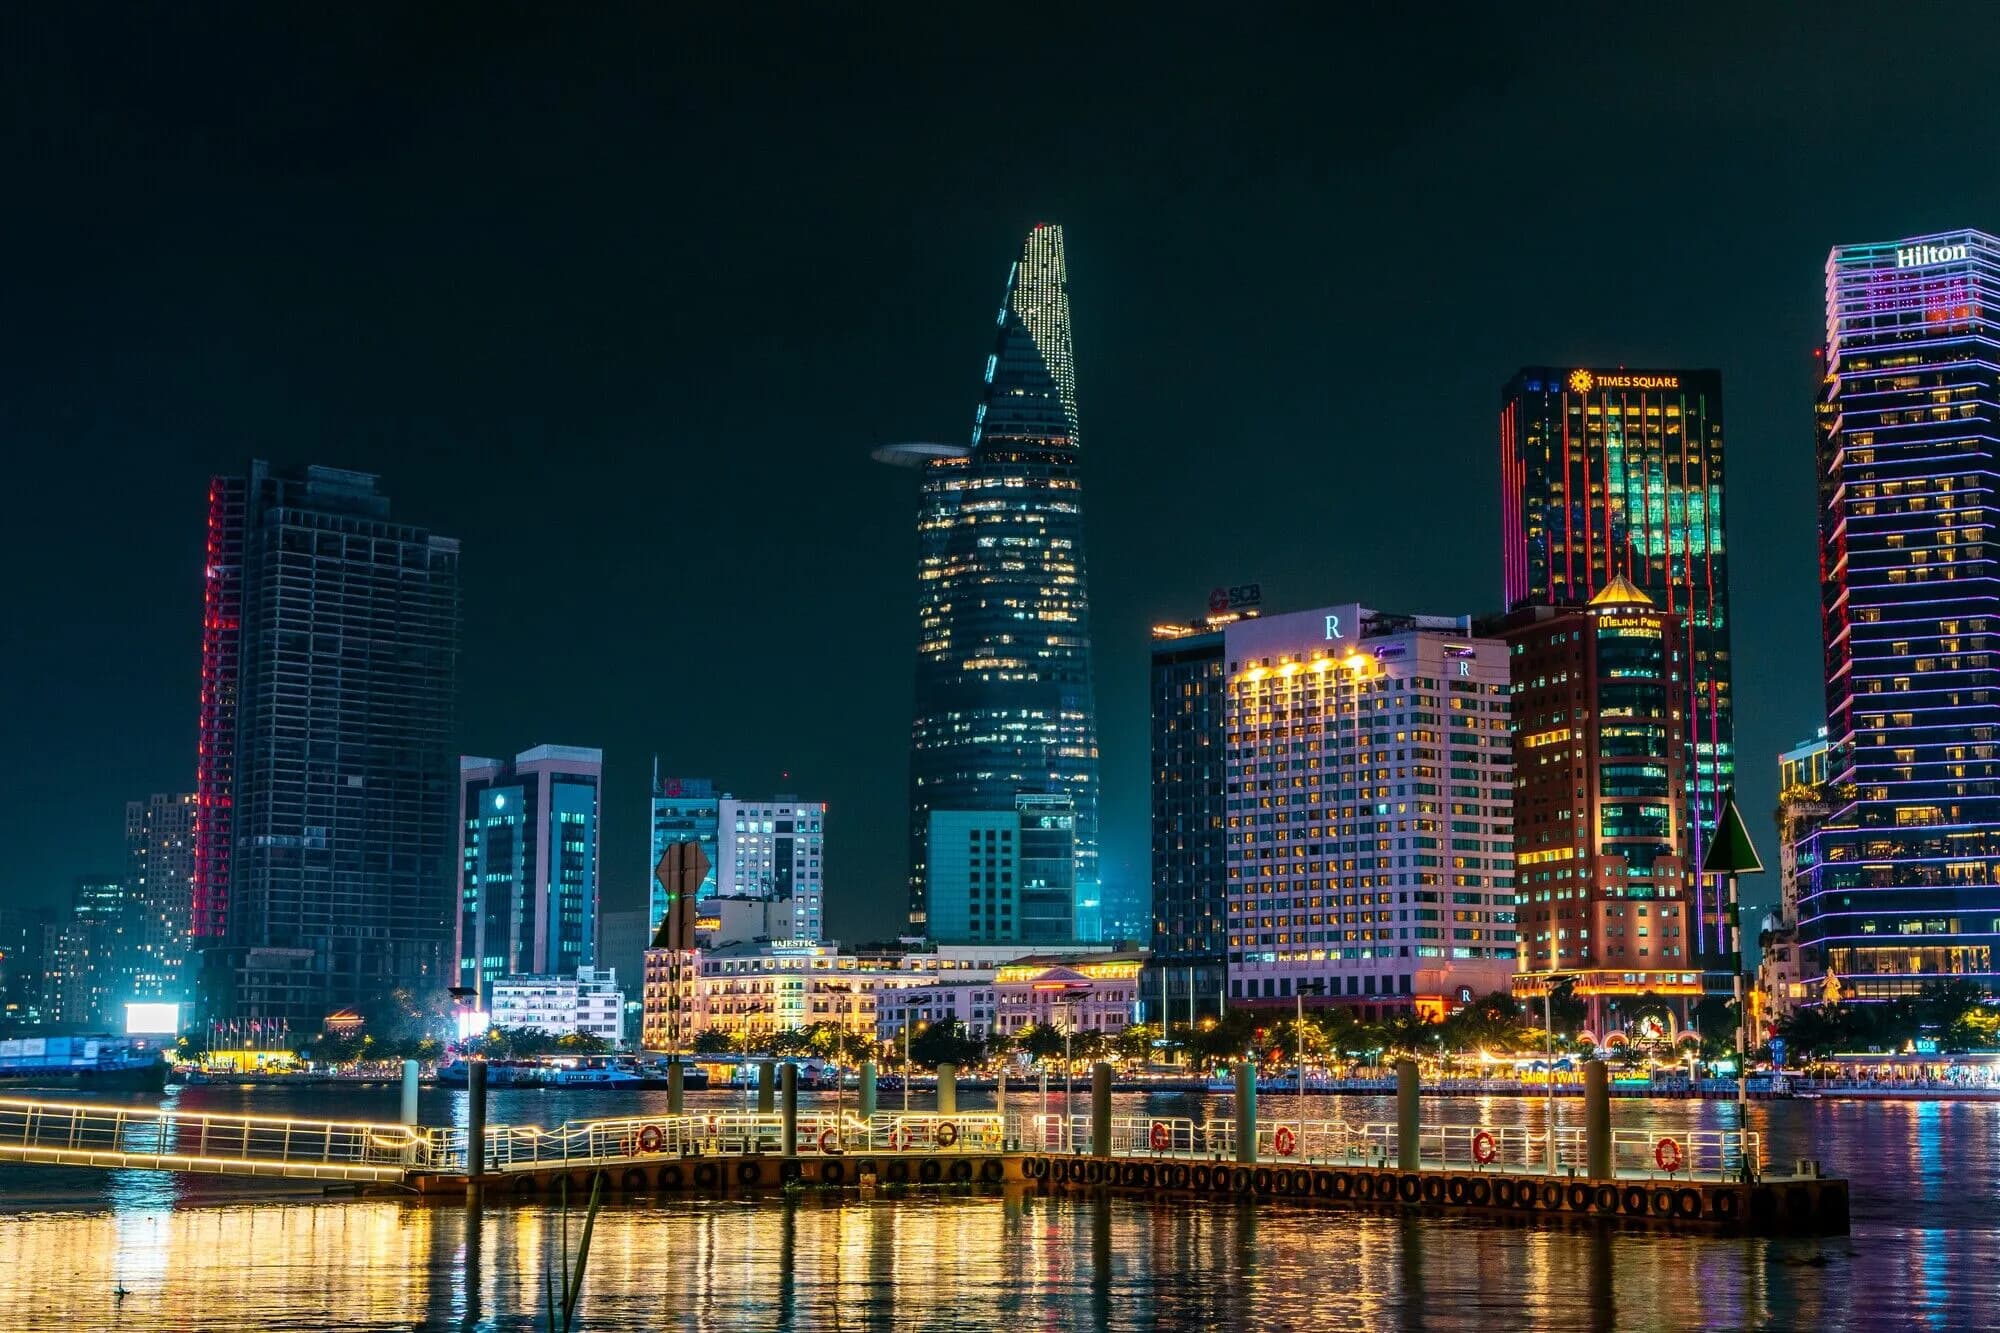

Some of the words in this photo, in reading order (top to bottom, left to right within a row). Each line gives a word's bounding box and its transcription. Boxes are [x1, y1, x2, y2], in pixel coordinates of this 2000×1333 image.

[1897, 243, 1967, 268] Hilton
[1597, 376, 1631, 387] TIMES
[1633, 377, 1678, 388] SQUARE
[1325, 616, 1344, 640] R
[1460, 661, 1470, 677] R
[771, 940, 817, 948] MAJESTIC
[1462, 990, 1471, 1002] R
[1557, 1071, 1585, 1083] WATE
